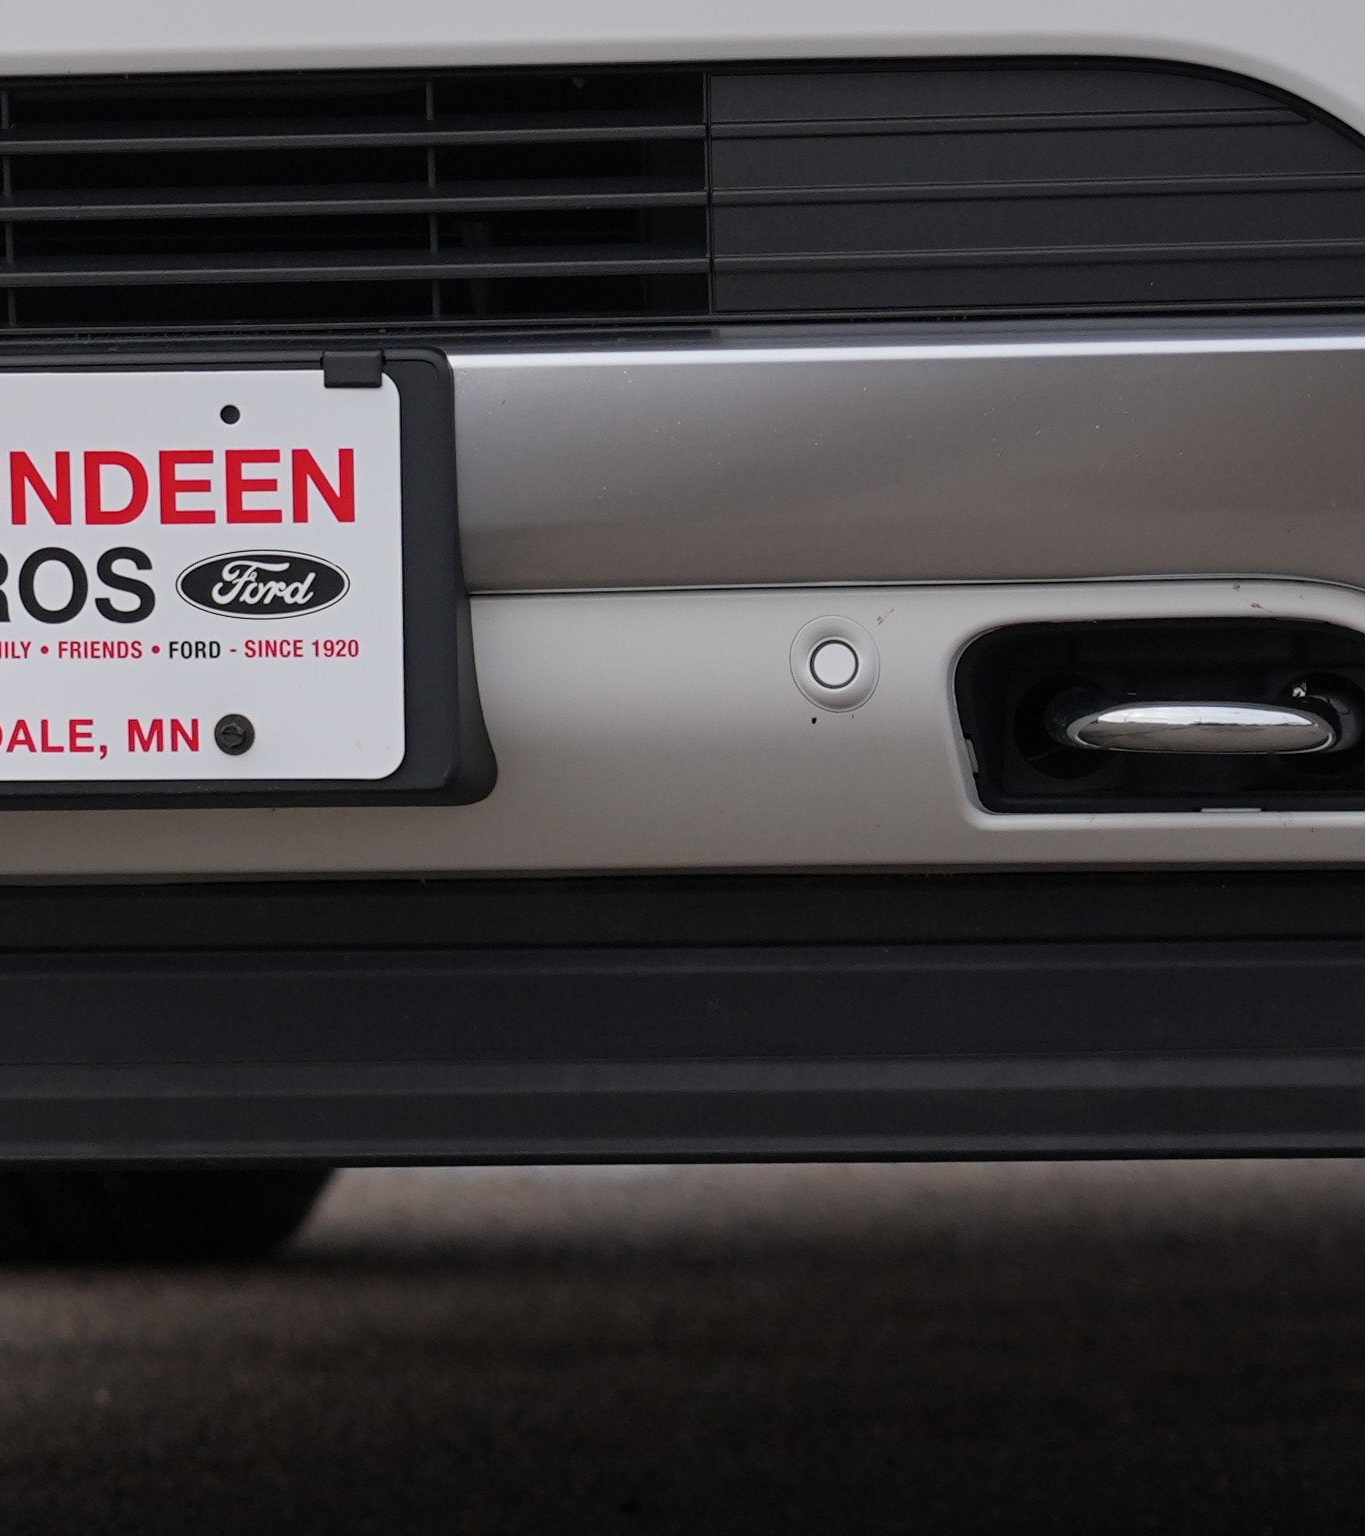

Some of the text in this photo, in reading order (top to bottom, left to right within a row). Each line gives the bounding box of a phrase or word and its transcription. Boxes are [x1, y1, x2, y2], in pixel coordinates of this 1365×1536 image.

[211, 560, 316, 606] Ford
[58, 640, 143, 660] FRIENDS
[168, 640, 221, 660] FORD
[244, 639, 304, 659] SINCE
[311, 639, 360, 658] 1920
[127, 718, 200, 753] MN
